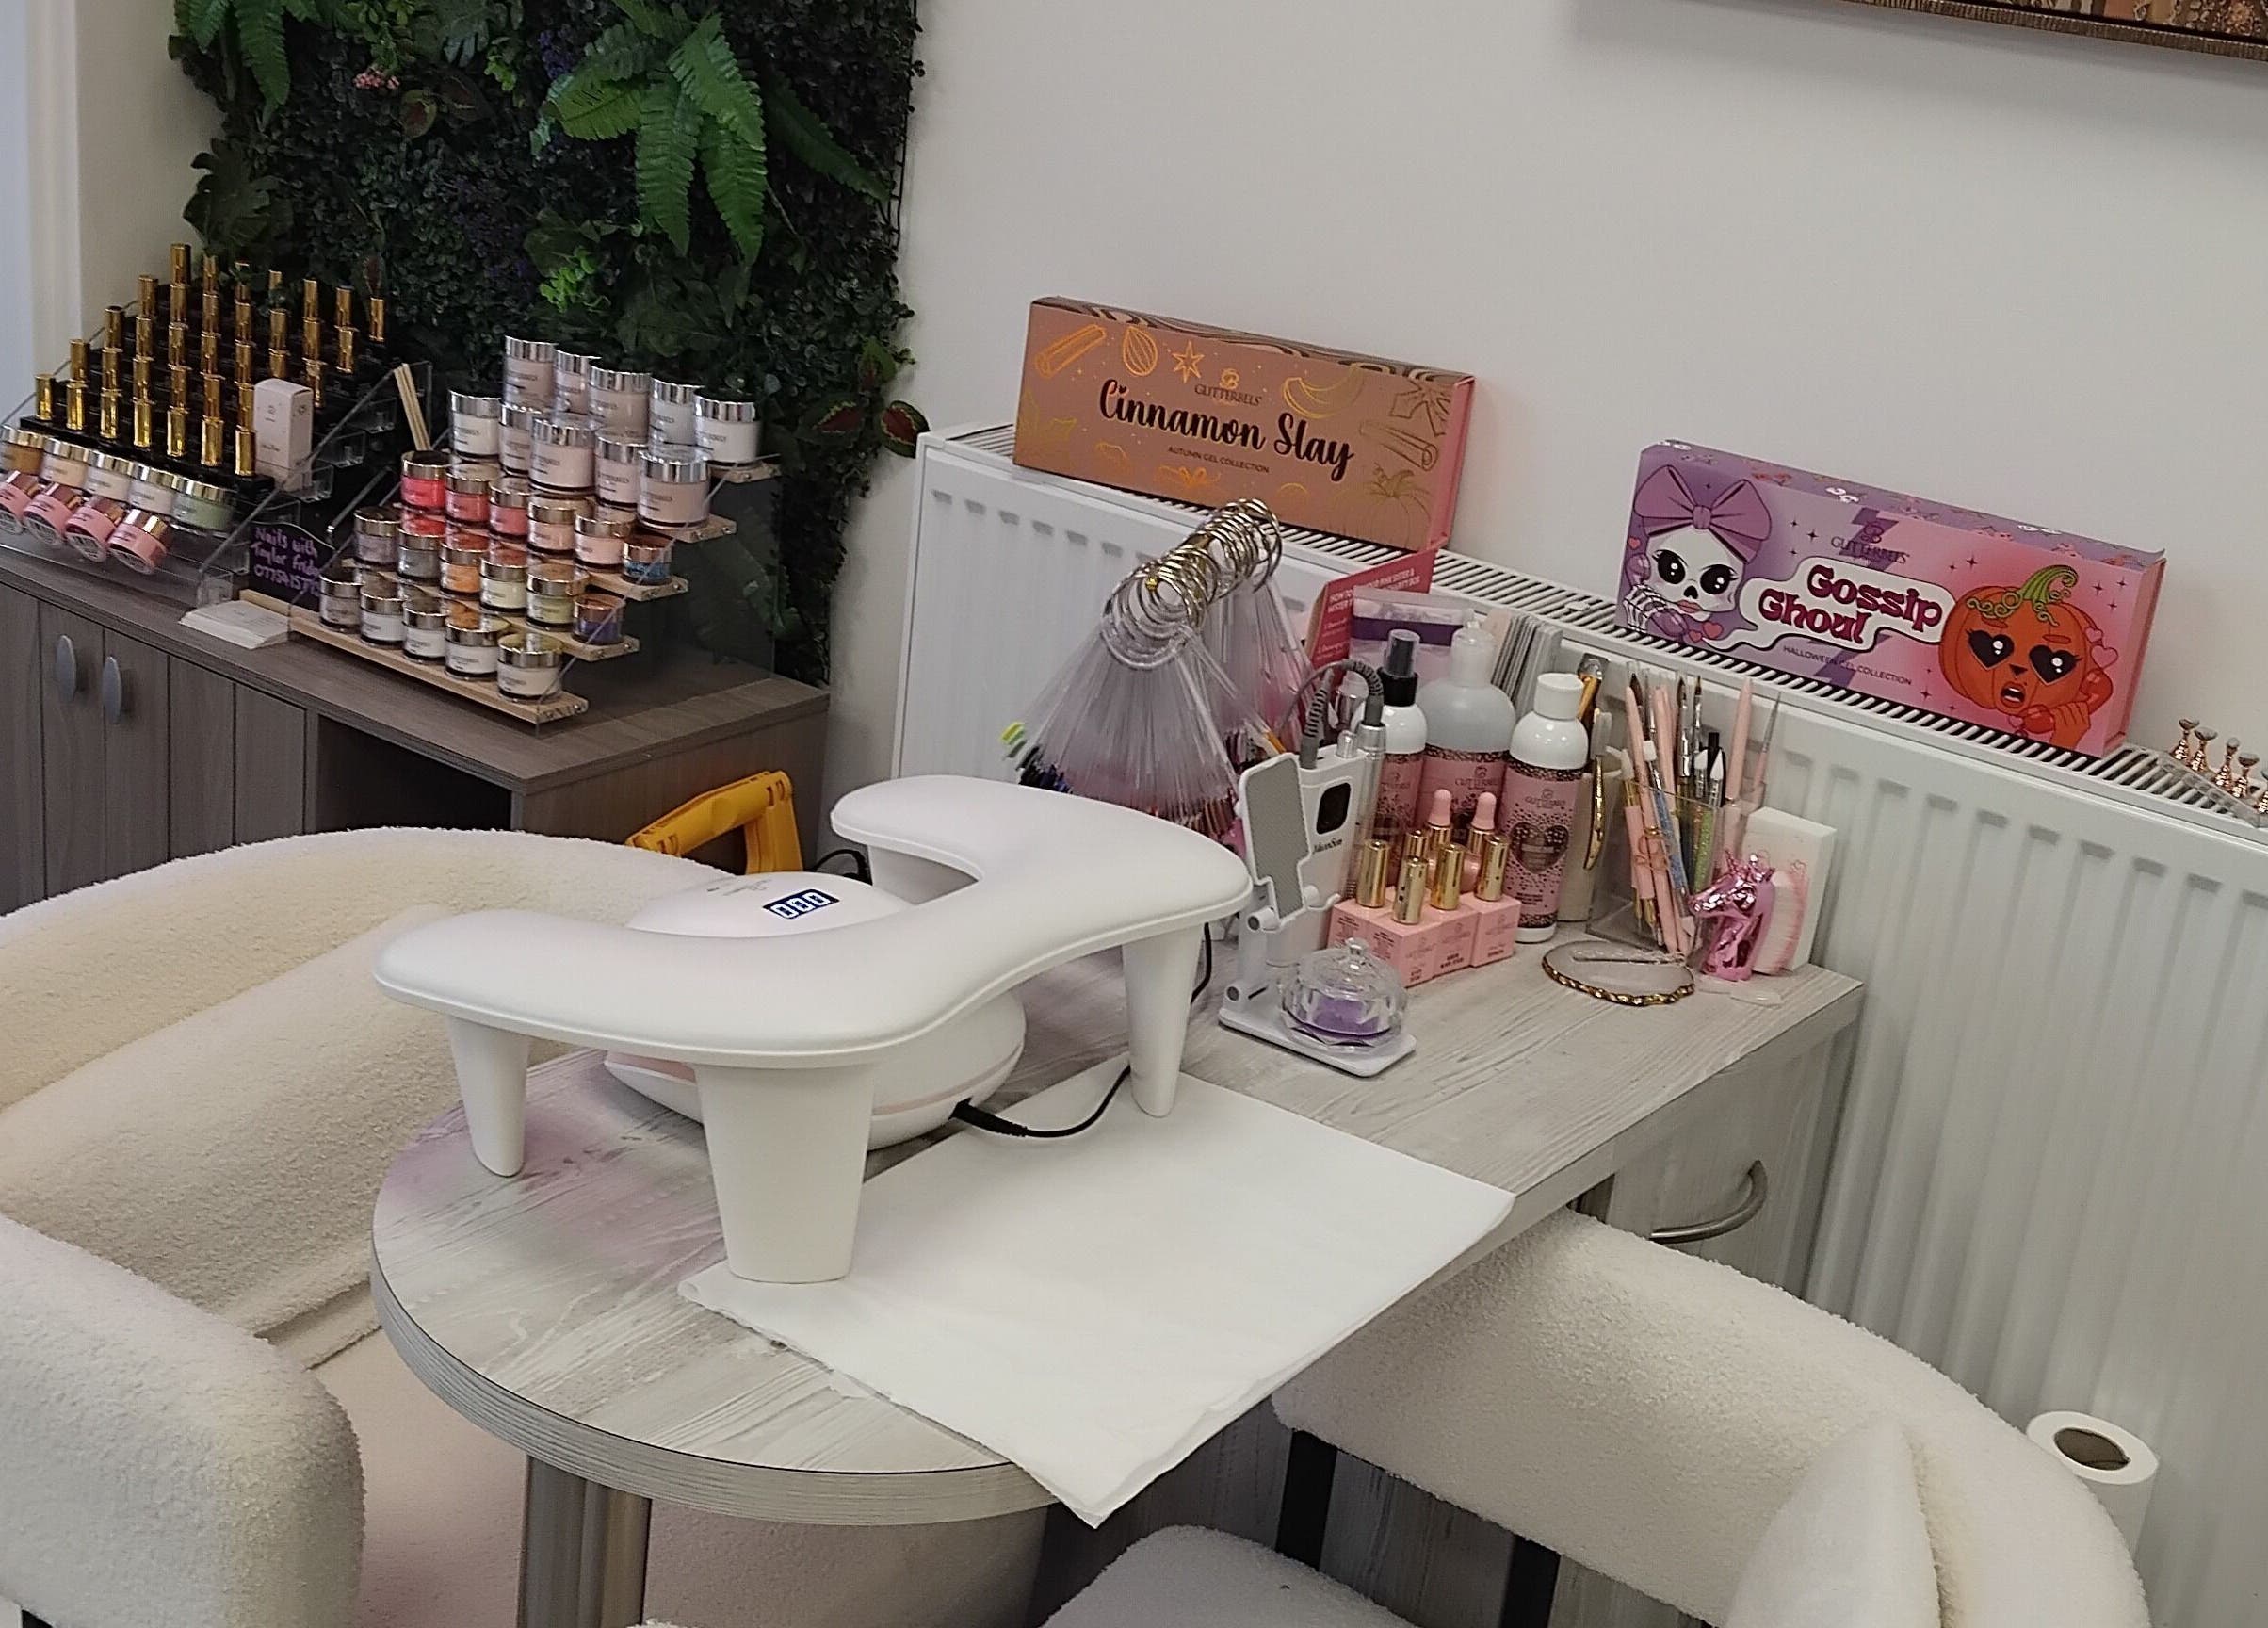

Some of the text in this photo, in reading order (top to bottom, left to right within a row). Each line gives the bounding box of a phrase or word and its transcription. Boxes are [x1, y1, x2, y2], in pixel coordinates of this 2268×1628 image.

[1099, 379, 1354, 482] Cinnamon Slay
[1168, 447, 1270, 473] AUTUMN GEL COLLECTION
[1758, 588, 1872, 644] Ghoul
[1807, 564, 1942, 632] Gossip
[1783, 645, 1837, 665] HALLOWEEN
[1857, 664, 1913, 686] COLLECTION
